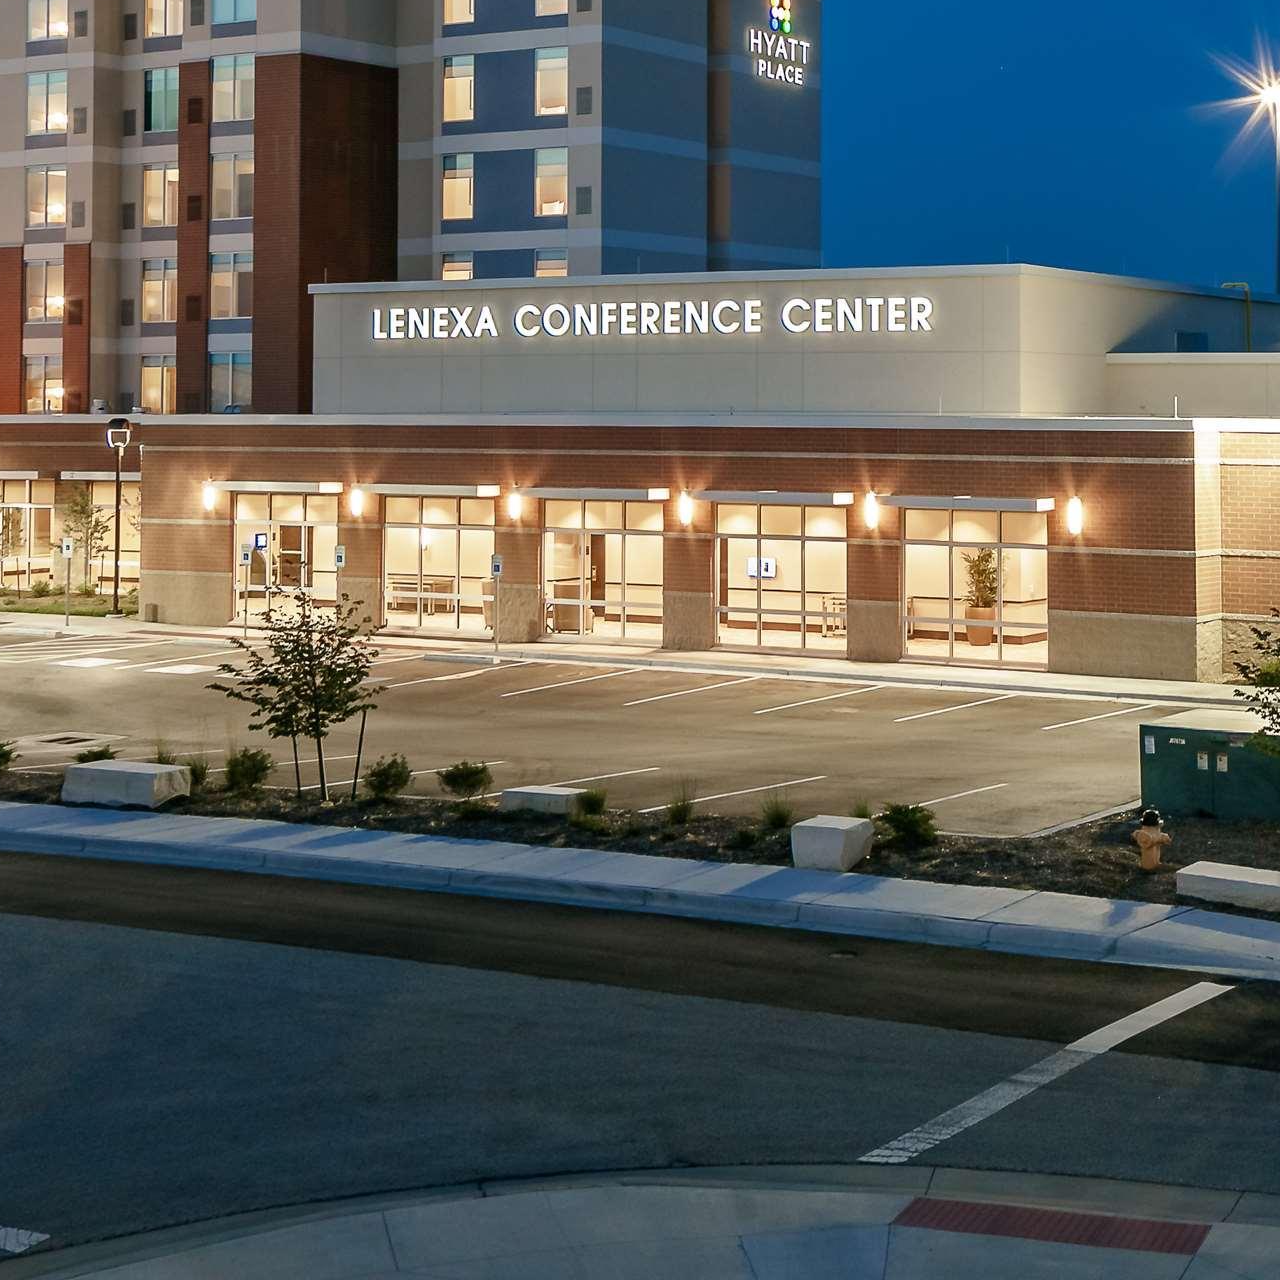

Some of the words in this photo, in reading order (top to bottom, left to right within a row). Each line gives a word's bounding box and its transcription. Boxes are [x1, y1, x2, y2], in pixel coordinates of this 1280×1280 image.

[749, 28, 811, 65] HYATT
[757, 59, 804, 86] PLACE
[371, 306, 498, 340] LENEXA
[514, 298, 763, 337] CONFERENCE
[781, 296, 935, 334] CENTER
